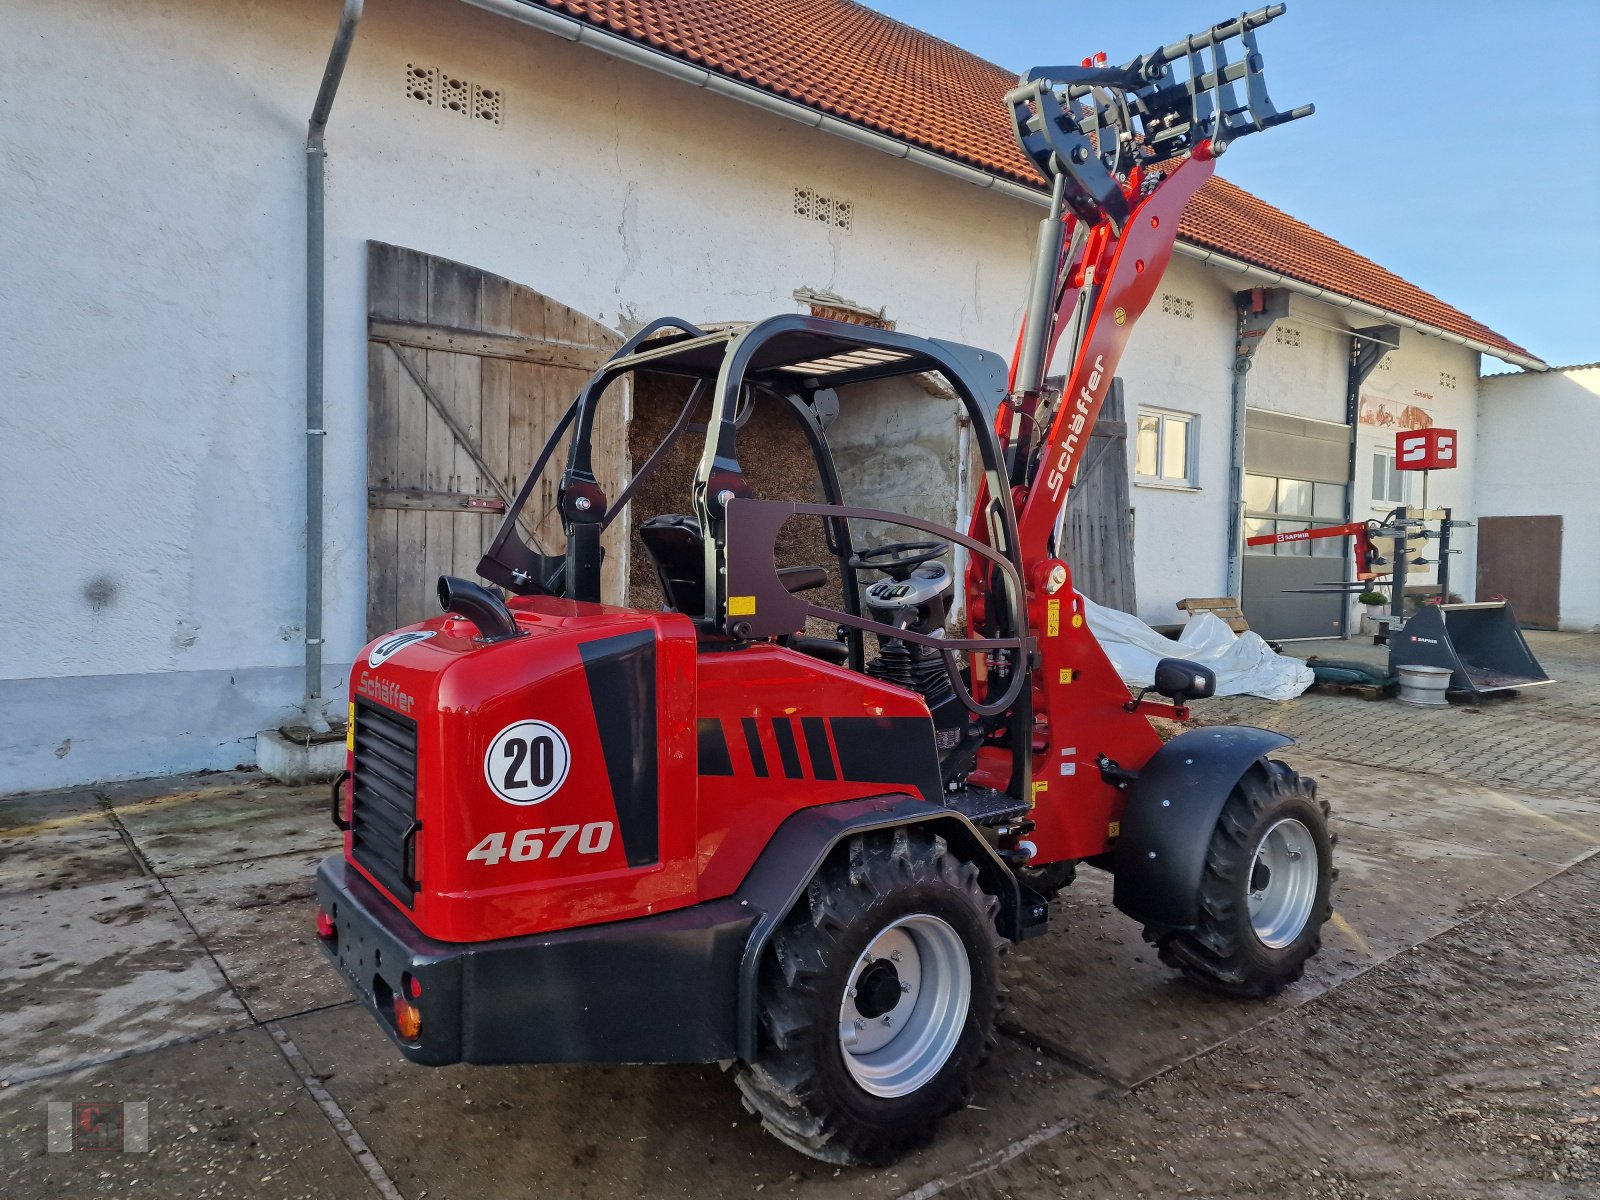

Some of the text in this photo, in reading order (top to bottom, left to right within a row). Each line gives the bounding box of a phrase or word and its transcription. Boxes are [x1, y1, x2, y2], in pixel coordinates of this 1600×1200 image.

[1047, 354, 1104, 503] Schäffer
[1284, 532, 1309, 540] SAPHIR
[357, 670, 415, 713] Schäffer
[503, 735, 554, 790] 20
[466, 820, 614, 866] 4670
